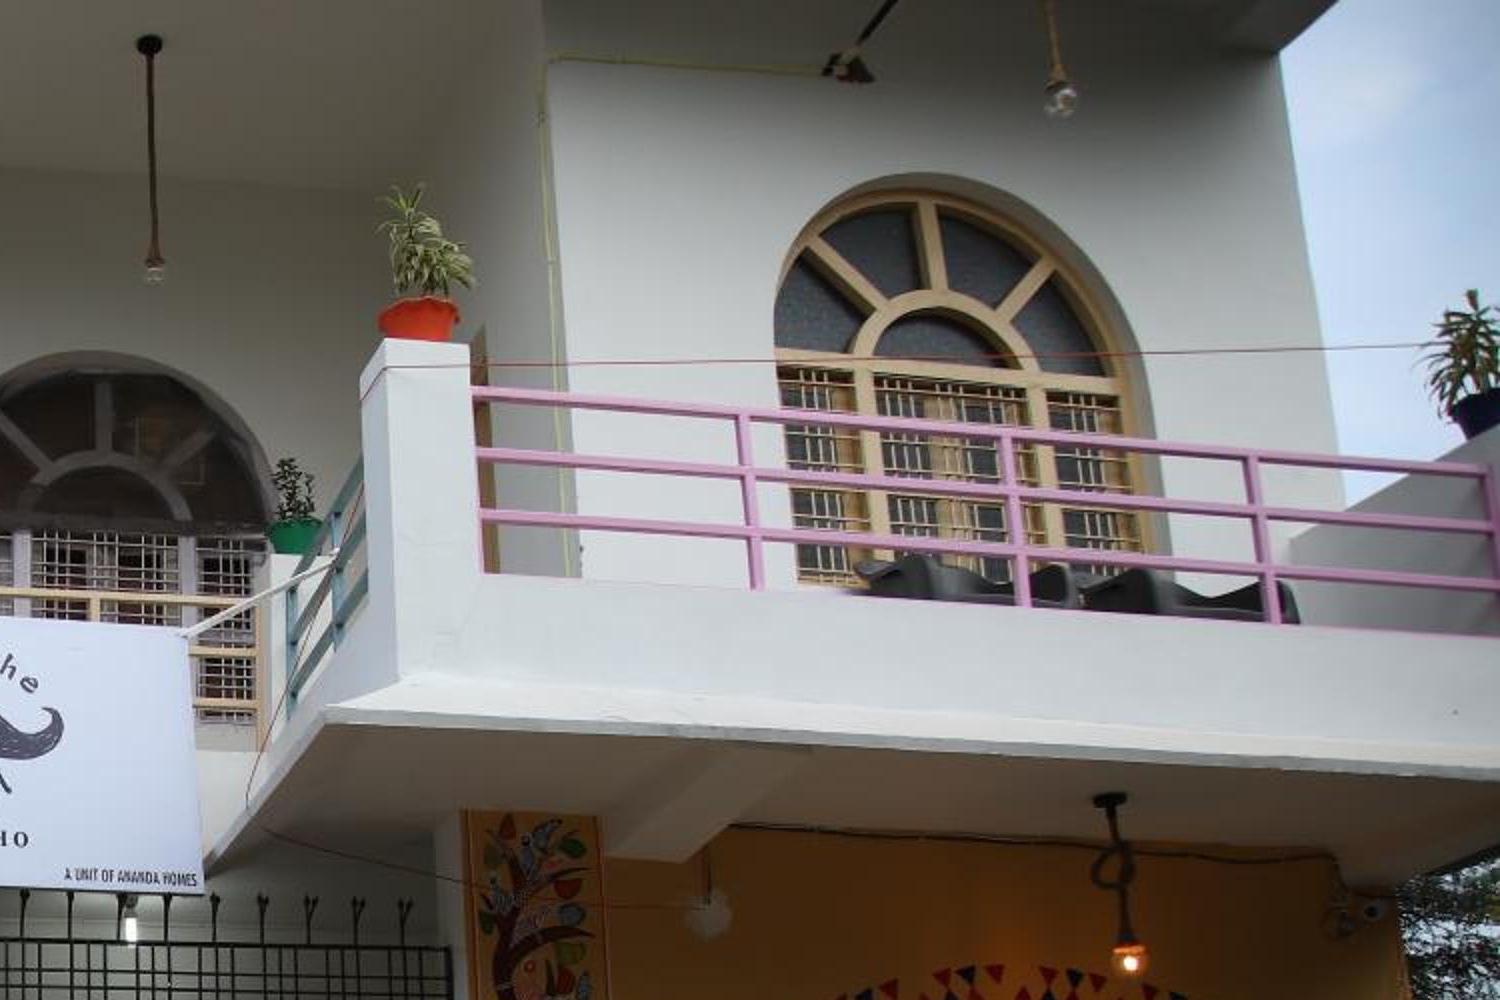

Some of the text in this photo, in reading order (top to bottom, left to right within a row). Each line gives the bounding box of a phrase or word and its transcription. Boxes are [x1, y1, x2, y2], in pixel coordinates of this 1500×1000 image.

[64, 867, 197, 887] A UNIT OF ANANDA HOMES
